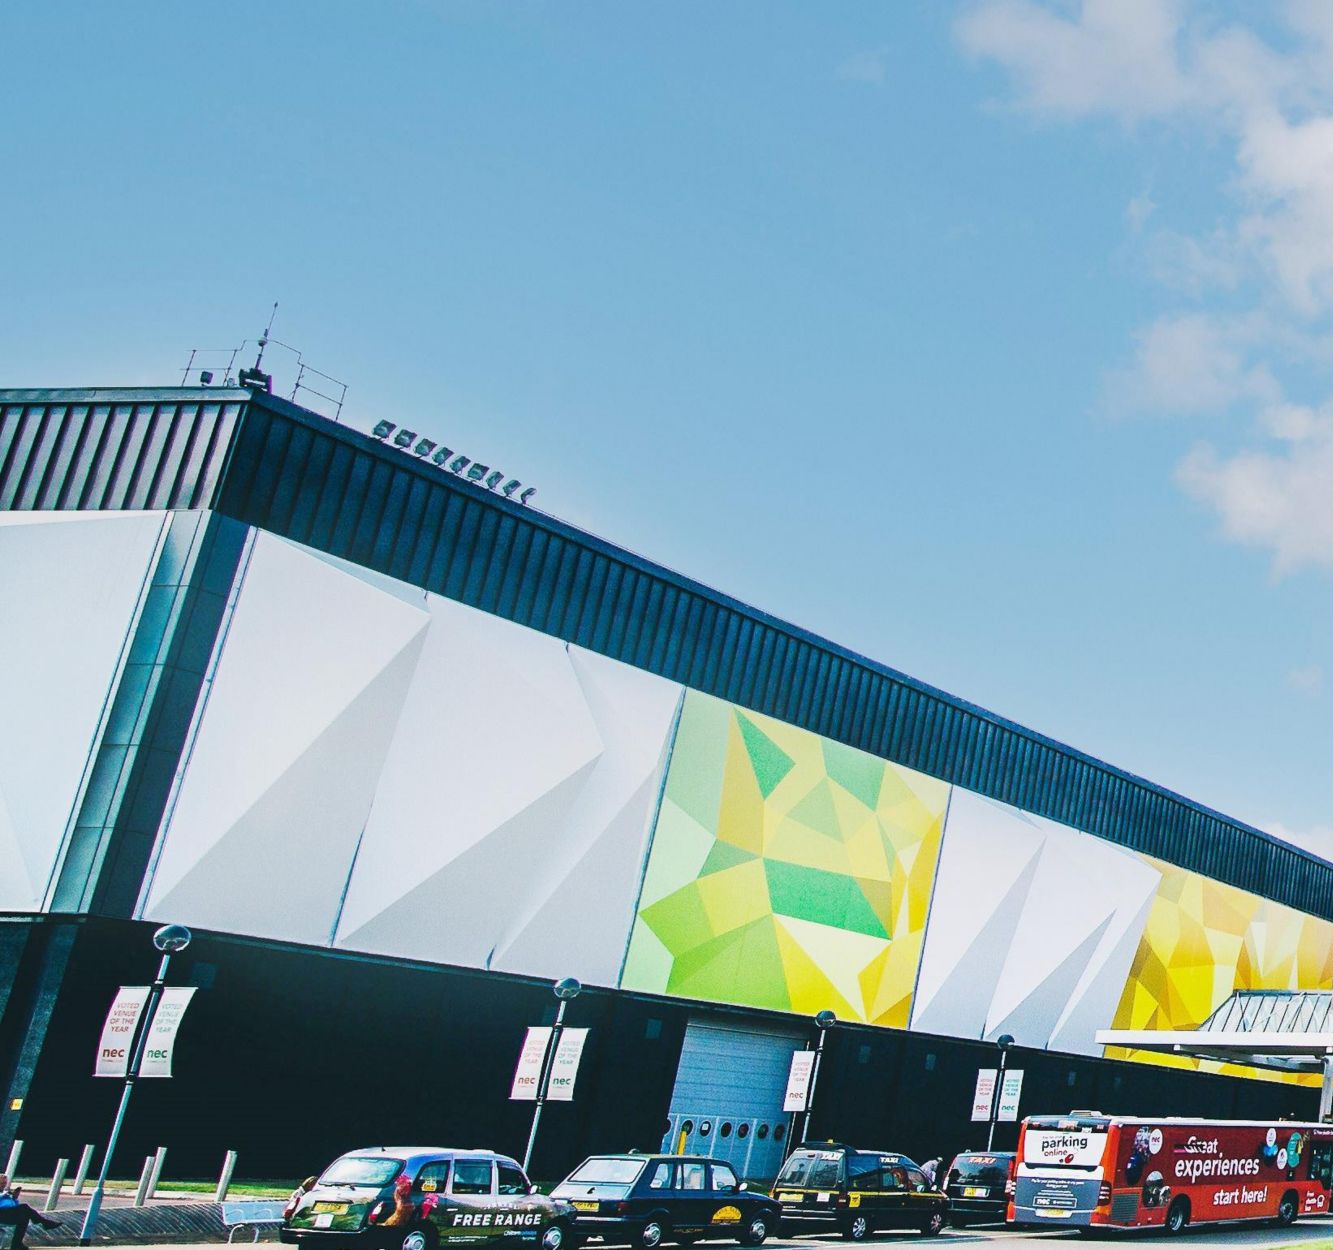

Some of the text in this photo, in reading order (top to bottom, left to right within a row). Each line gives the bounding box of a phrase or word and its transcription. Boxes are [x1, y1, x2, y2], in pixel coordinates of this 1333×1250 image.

[102, 1049, 125, 1058] nec
[147, 1049, 168, 1058] nec
[1042, 1136, 1088, 1151] parking
[1184, 1136, 1218, 1153] Great
[1044, 1148, 1068, 1156] online
[969, 1156, 997, 1164] TAXI
[1175, 1152, 1260, 1183] experiences
[1213, 1186, 1268, 1205] start here!
[453, 1214, 542, 1226] FREE RANGE
